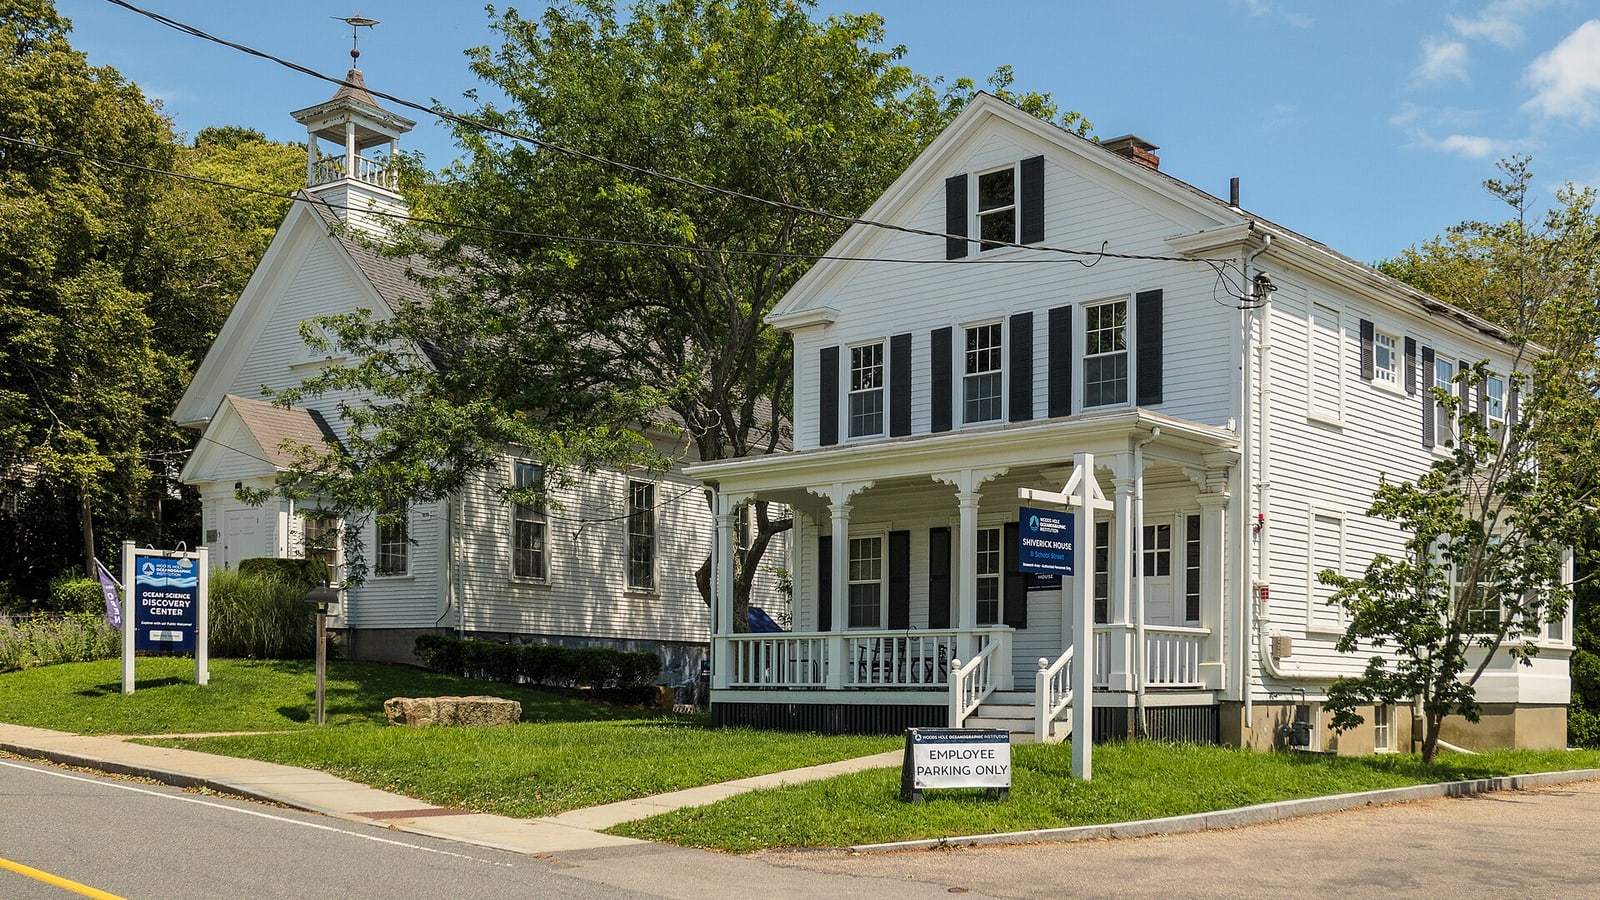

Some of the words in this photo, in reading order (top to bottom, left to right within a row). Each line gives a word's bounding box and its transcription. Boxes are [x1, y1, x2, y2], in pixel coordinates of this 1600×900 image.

[1022, 538, 1052, 547] SHIVERICK
[1053, 542, 1072, 550] HOUSE
[142, 599, 191, 607] DISCOVERY
[929, 750, 995, 760] EMPLOYEE
[917, 766, 971, 775] PARKING
[975, 765, 1008, 775] ONLY
